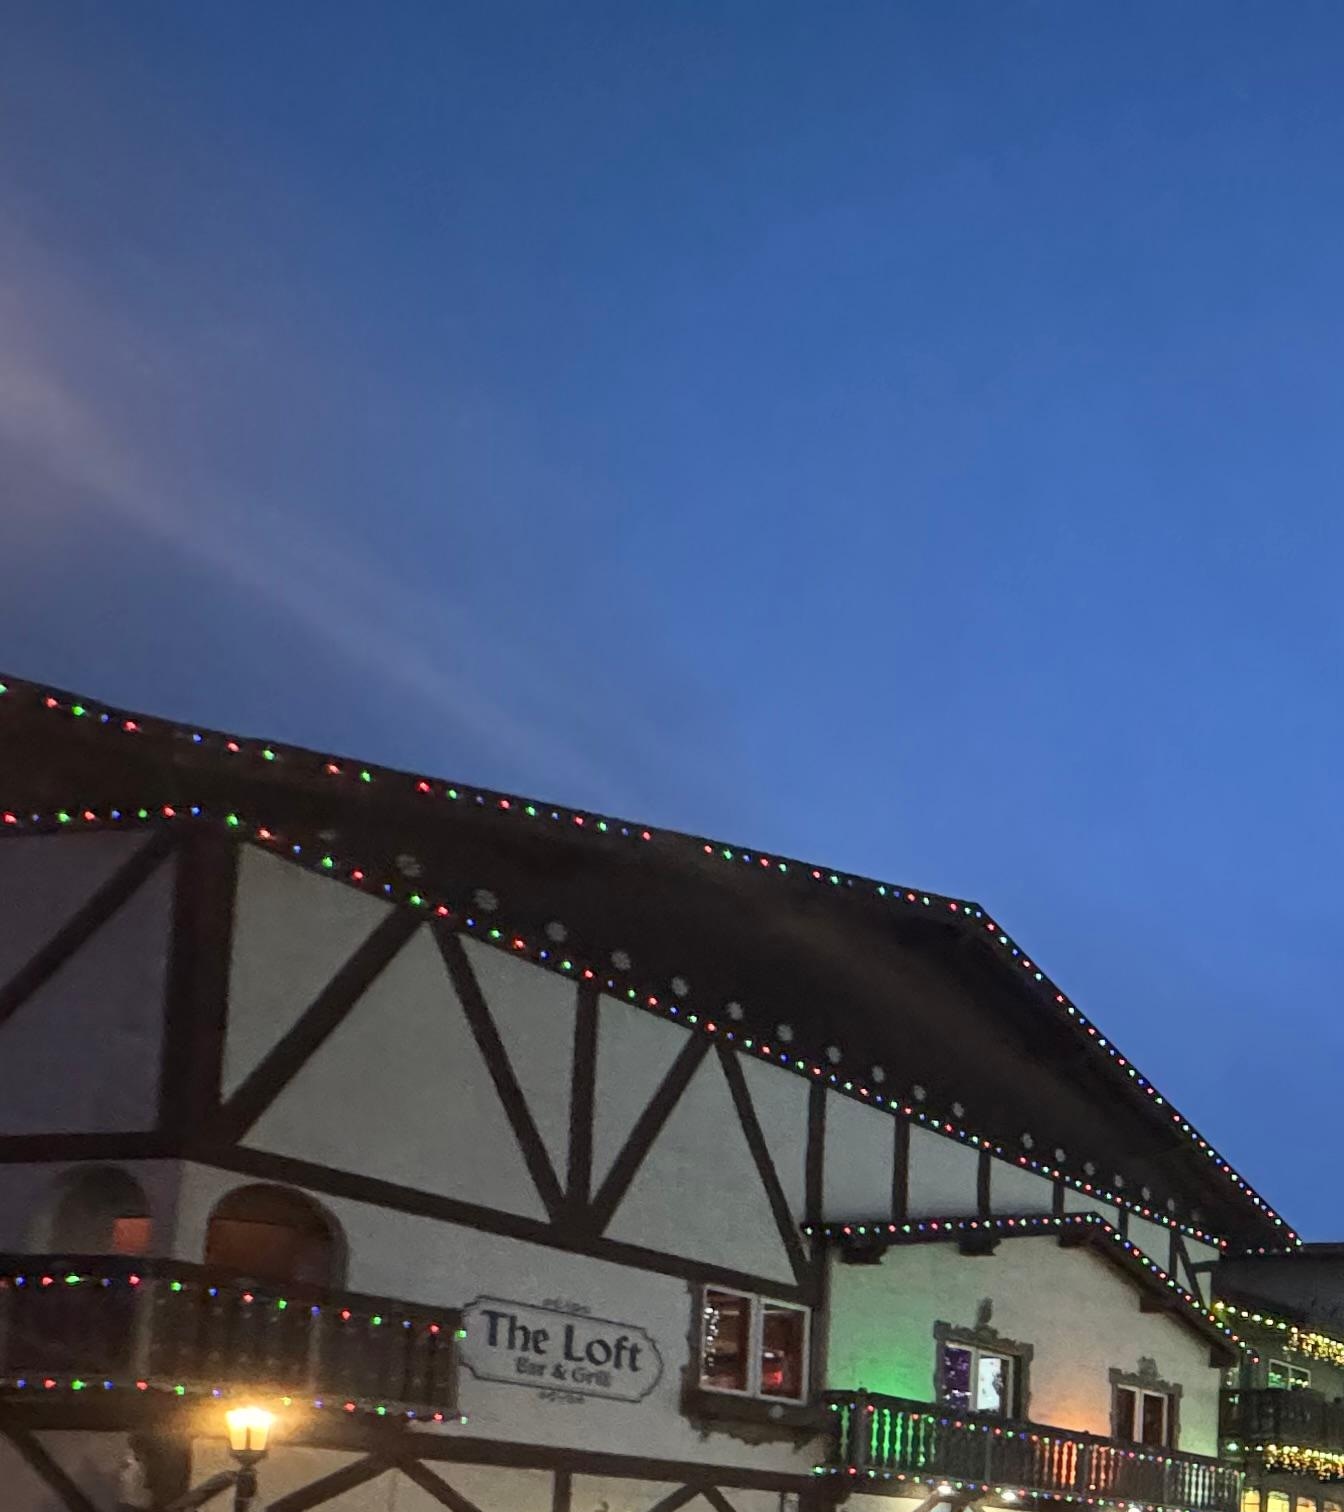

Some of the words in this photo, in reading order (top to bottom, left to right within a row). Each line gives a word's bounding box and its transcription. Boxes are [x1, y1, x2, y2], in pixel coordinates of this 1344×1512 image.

[481, 1310, 549, 1355] The
[564, 1323, 643, 1373] Loft
[551, 1362, 567, 1382] &
